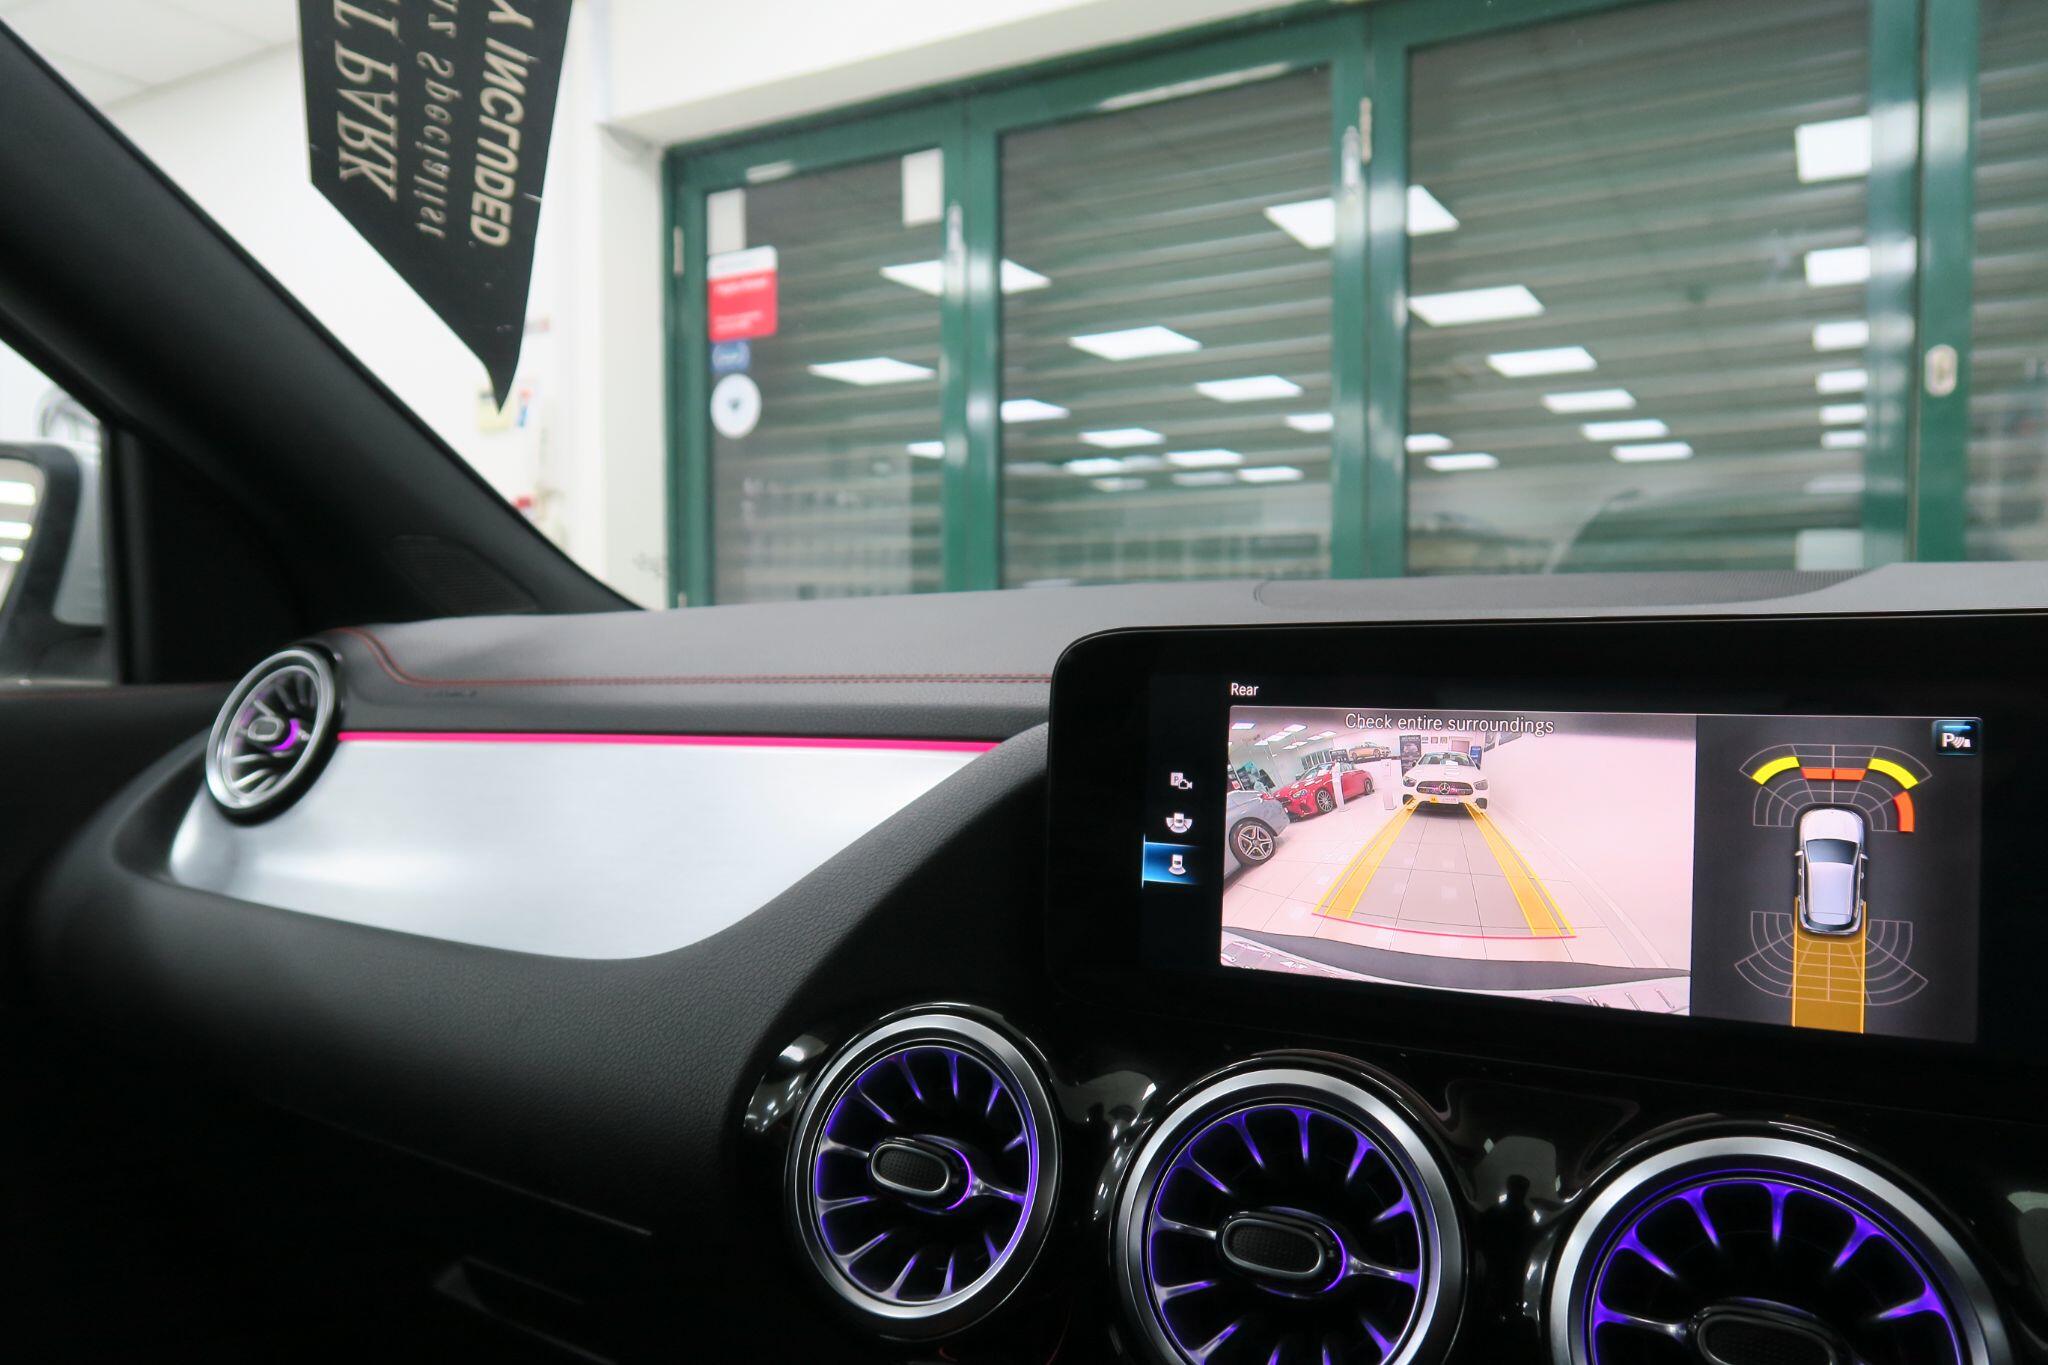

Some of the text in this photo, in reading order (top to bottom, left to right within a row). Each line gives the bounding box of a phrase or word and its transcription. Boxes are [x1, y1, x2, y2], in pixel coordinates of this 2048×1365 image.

[1230, 682, 1259, 696] Rear
[1345, 713, 1555, 737] Check entire surroundings
